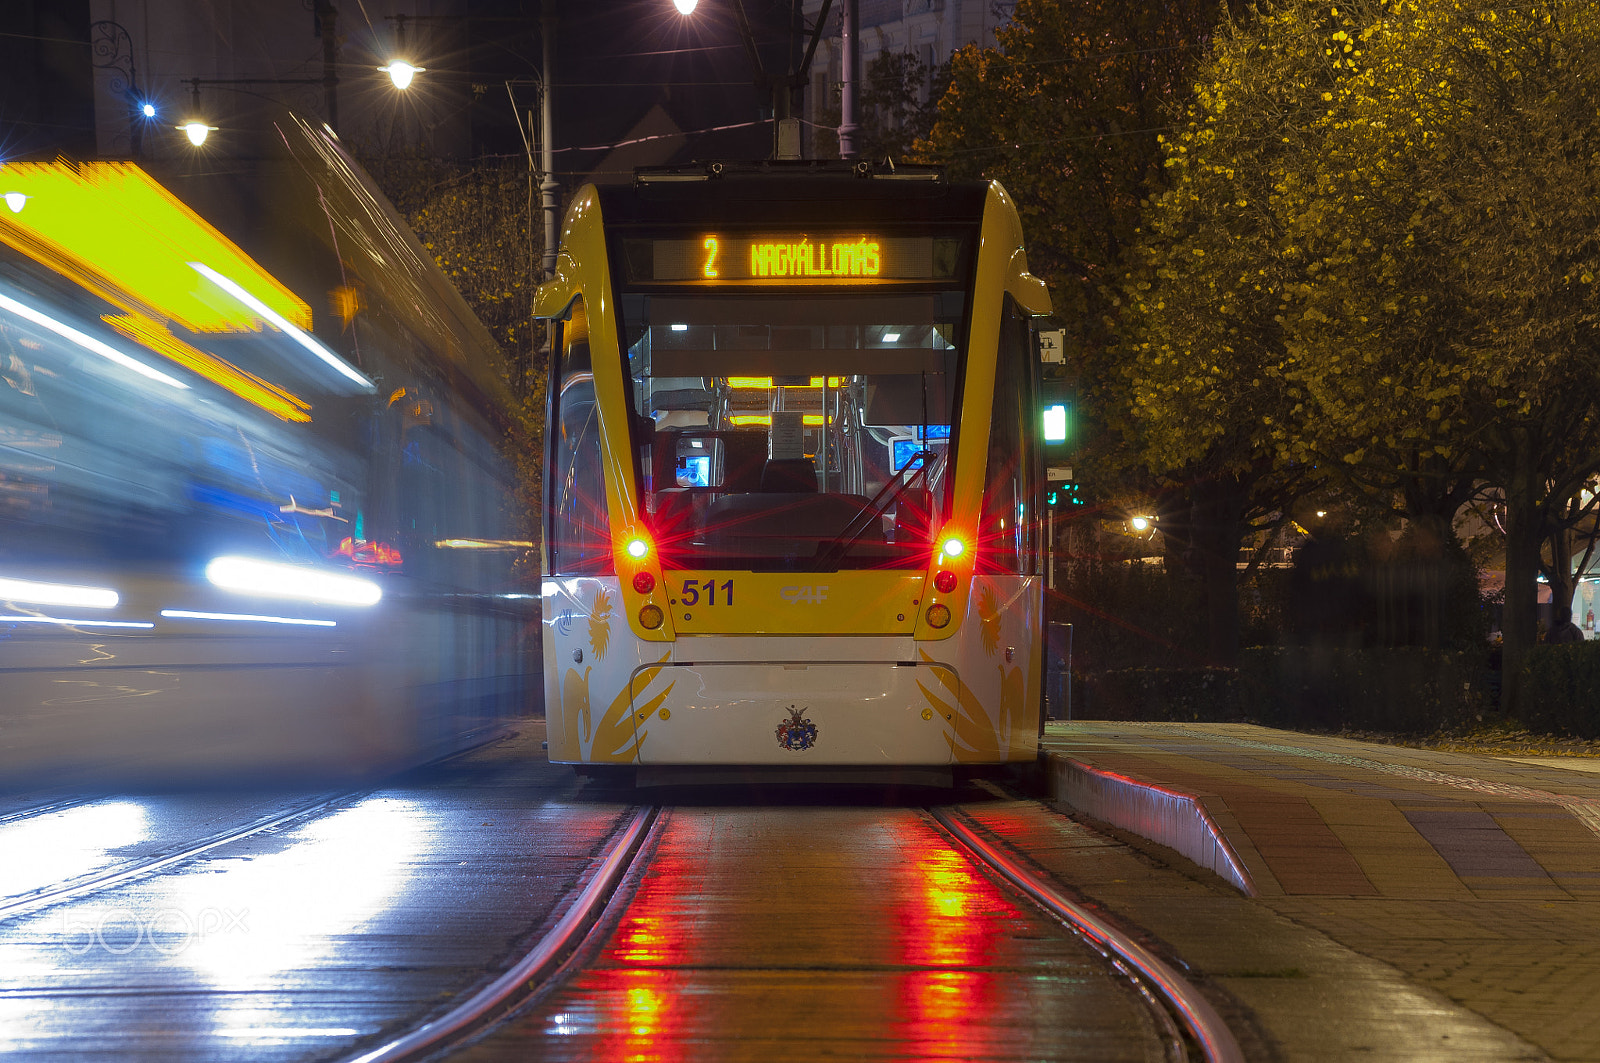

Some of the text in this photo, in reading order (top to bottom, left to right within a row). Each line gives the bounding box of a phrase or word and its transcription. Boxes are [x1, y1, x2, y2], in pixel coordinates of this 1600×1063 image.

[704, 236, 880, 277] 2 NAGYÁLLOMÁS
[681, 579, 734, 606] 511
[779, 585, 829, 605] CAF
